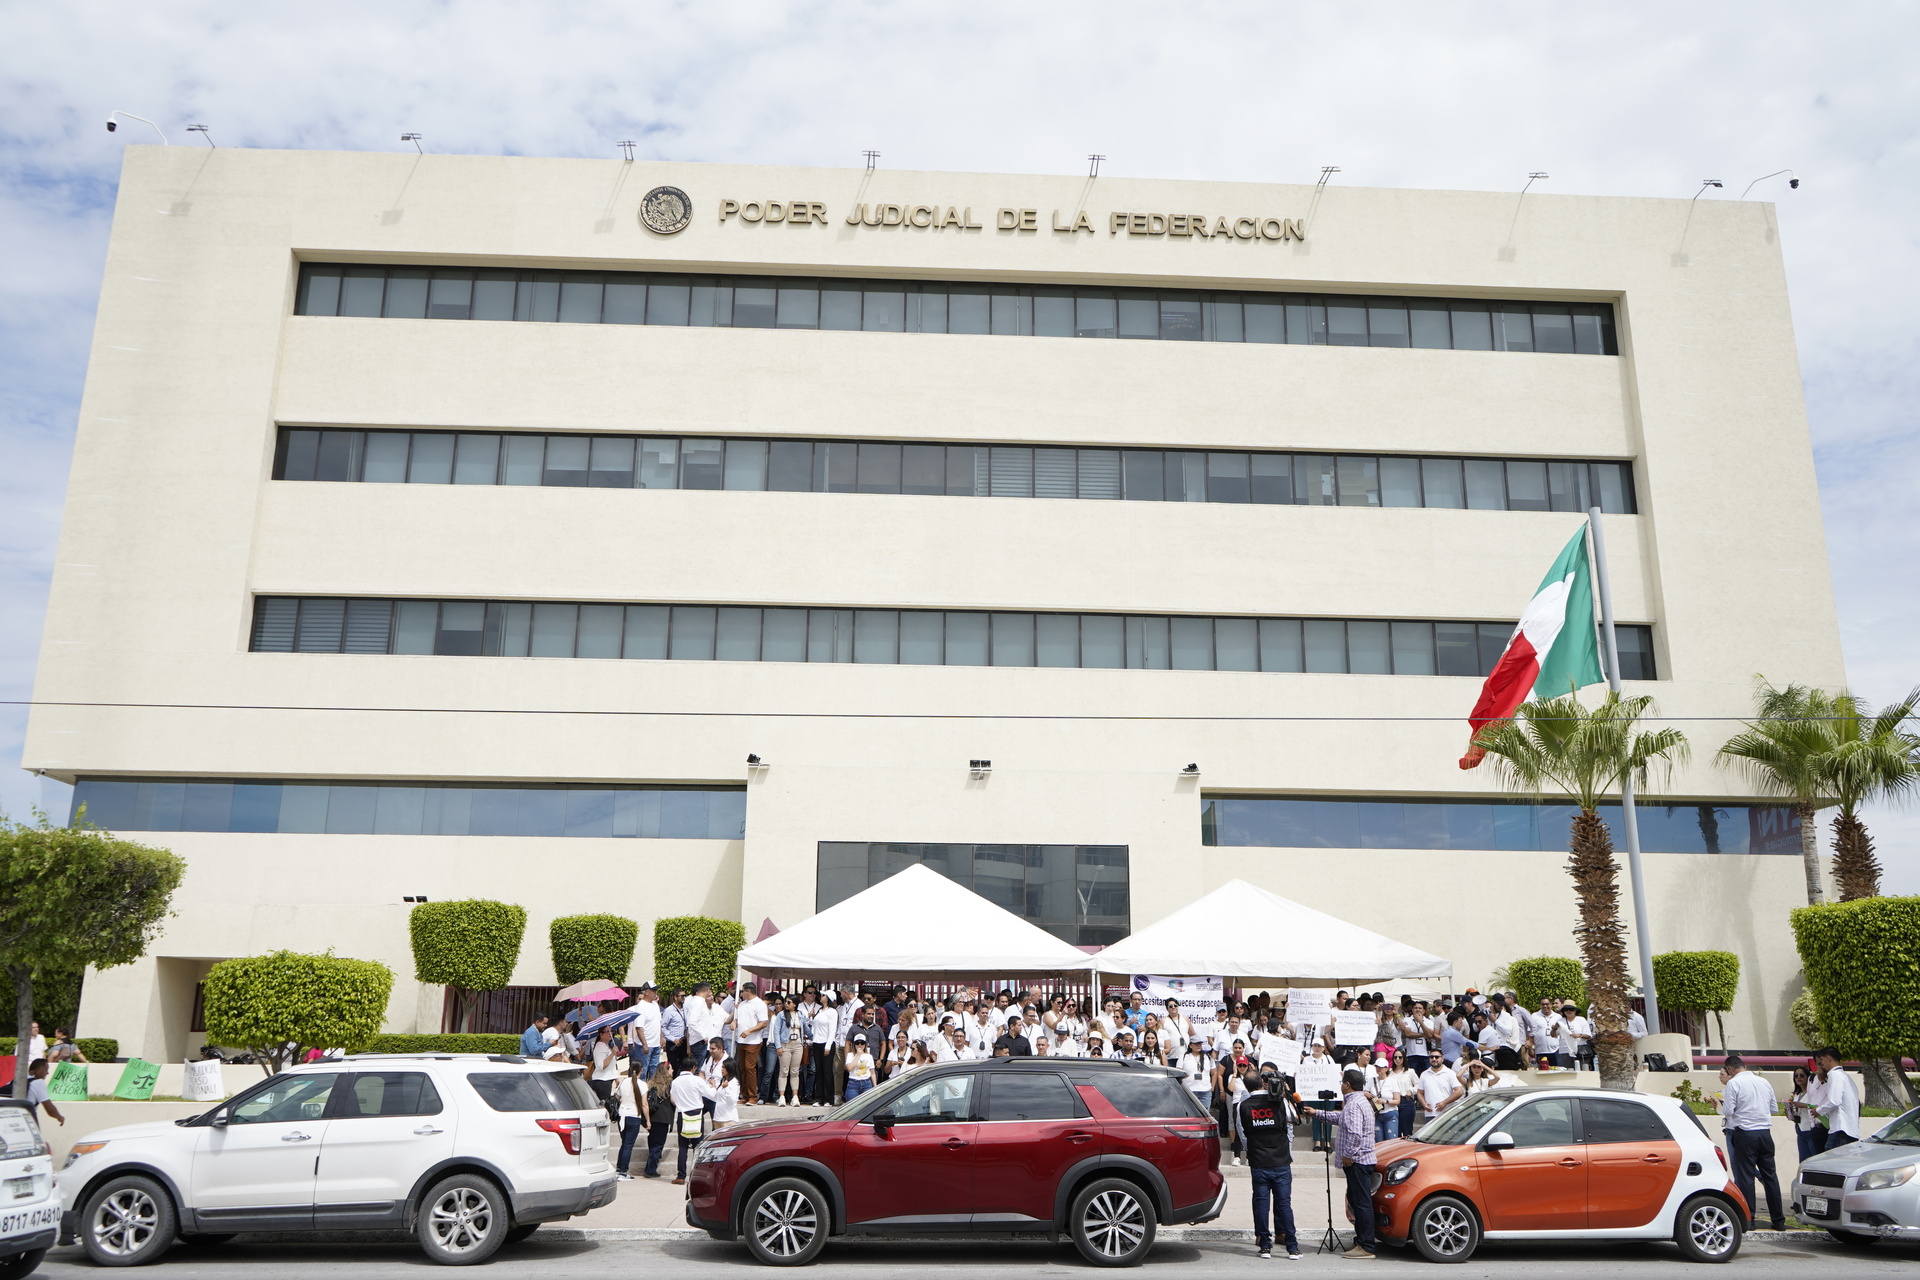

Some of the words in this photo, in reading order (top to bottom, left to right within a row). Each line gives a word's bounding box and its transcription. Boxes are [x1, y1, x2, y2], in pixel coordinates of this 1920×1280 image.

[719, 198, 829, 225] PODER
[845, 202, 983, 230] JUDICIAL
[997, 207, 1038, 231] DE
[1052, 208, 1096, 233] LA
[1110, 211, 1305, 241] FEDERACION
[1298, 1066, 1328, 1075] RESPETO
[1251, 1108, 1274, 1119] RCG
[1252, 1117, 1275, 1127] Media
[2, 1213, 28, 1233] 8717
[30, 1206, 61, 1228] 474810
